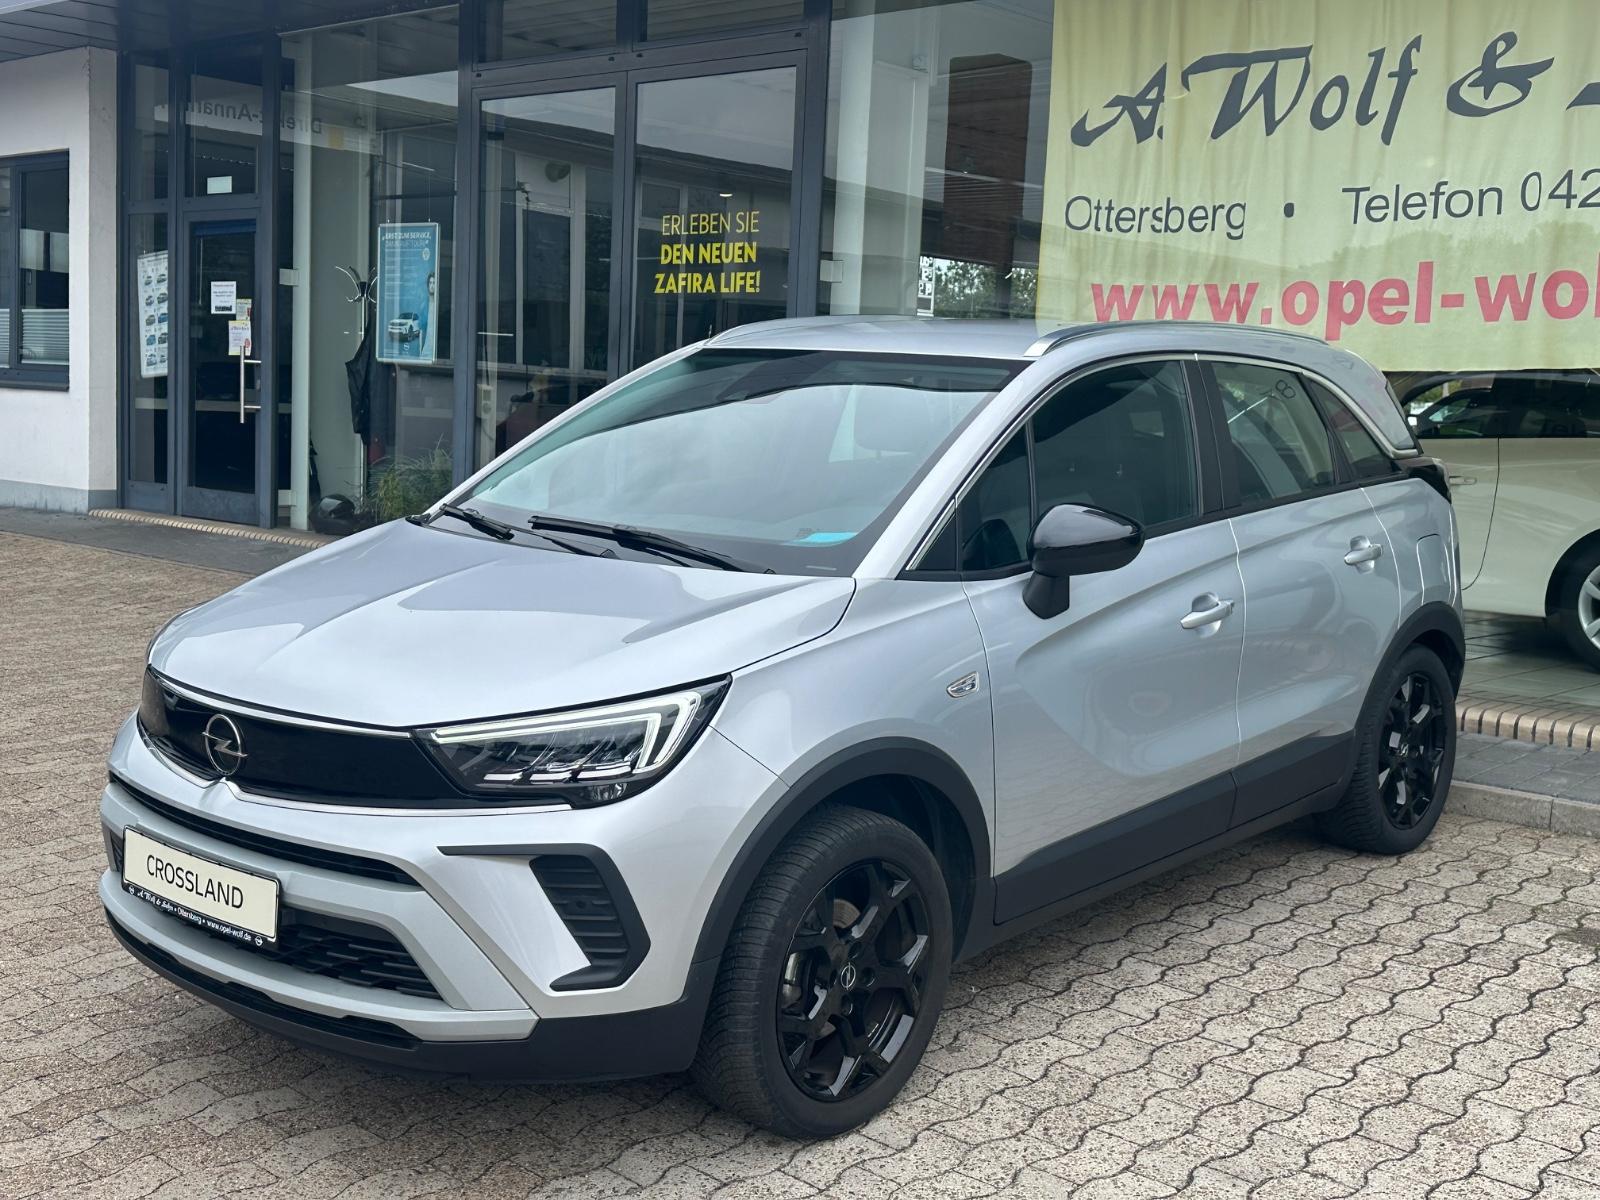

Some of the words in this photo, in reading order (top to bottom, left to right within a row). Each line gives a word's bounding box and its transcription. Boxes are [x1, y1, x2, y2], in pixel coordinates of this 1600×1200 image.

[1181, 34, 1422, 146] Wolf
[1446, 31, 1555, 118] &
[662, 212, 731, 236] ERLEBEN
[736, 210, 760, 233] SIE
[1065, 195, 1246, 240] Ottersberg
[1342, 181, 1502, 226] Telefon
[660, 243, 695, 265] DEN
[698, 241, 757, 264] NEUEN
[654, 272, 716, 294] ZAFIRA
[720, 270, 761, 293] LIFE!
[146, 854, 244, 909] CROSSLAND
